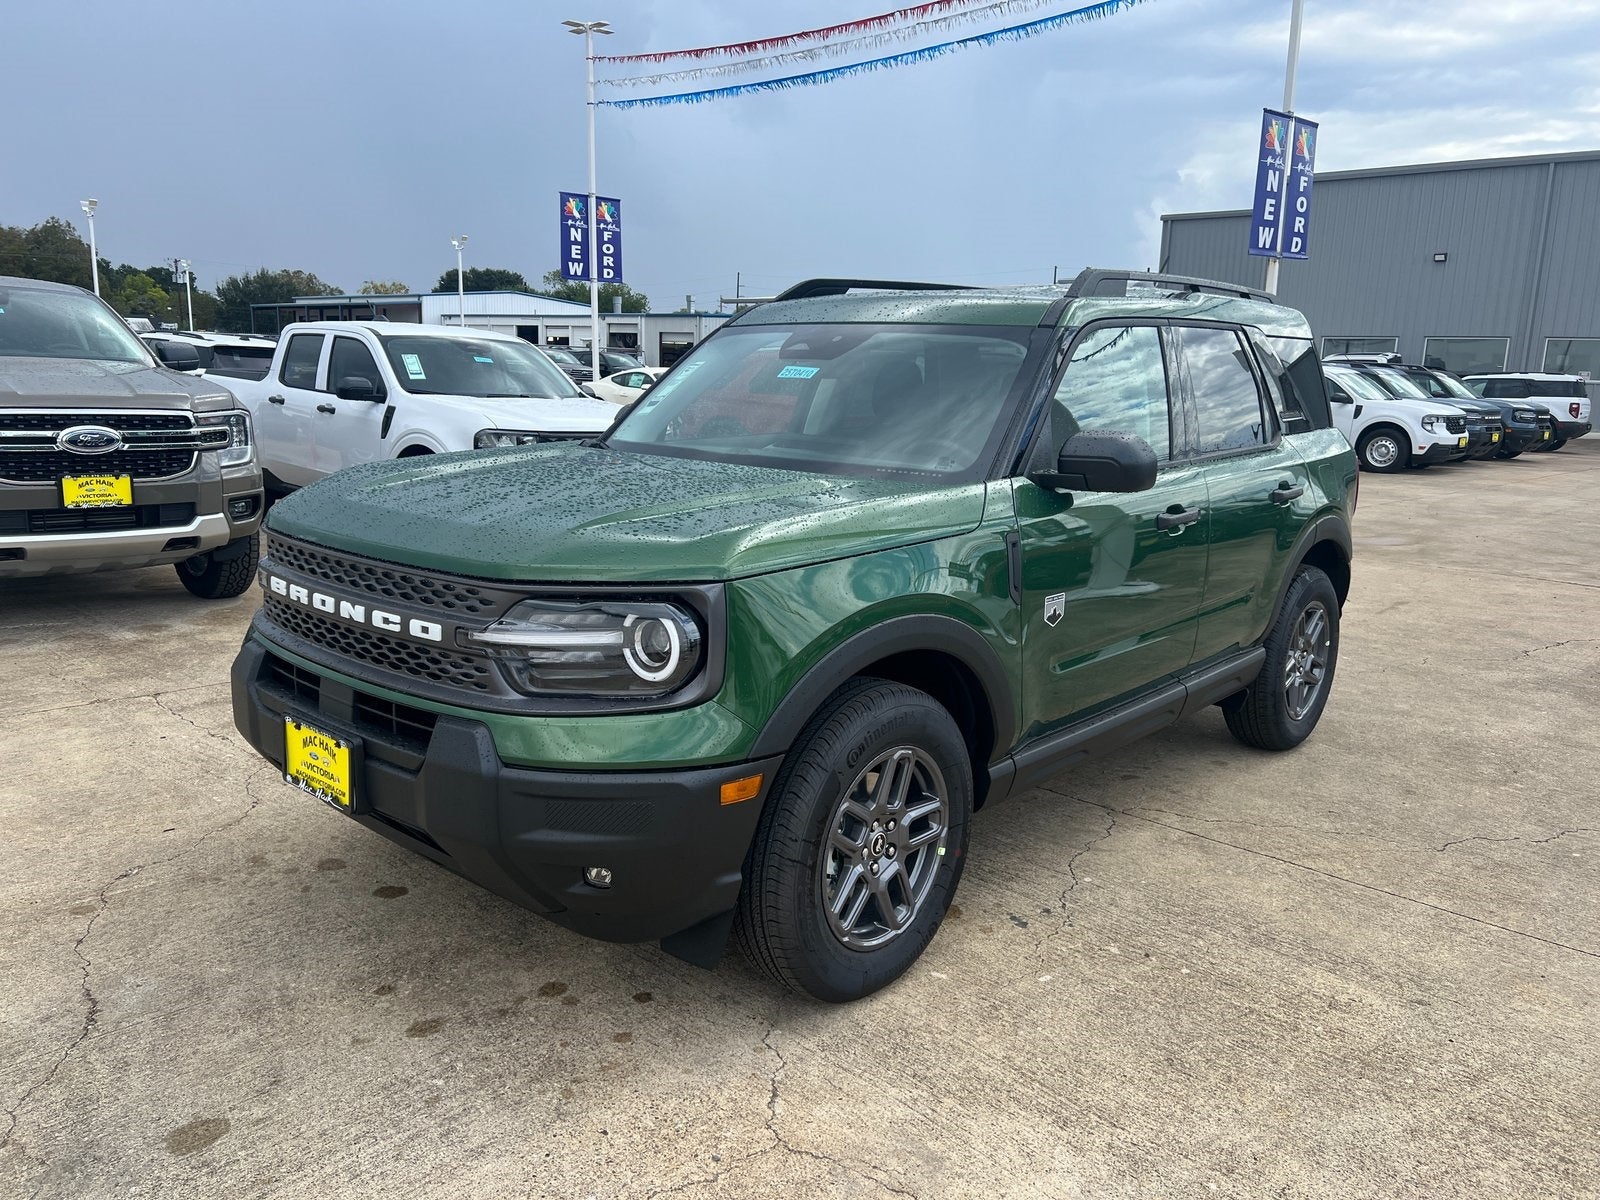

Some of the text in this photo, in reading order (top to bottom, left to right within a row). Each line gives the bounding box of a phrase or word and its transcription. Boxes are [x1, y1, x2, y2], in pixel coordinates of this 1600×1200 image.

[1258, 169, 1280, 249] NEW
[1290, 175, 1309, 254] FORD
[568, 227, 584, 276] NEW
[602, 231, 615, 279] FORD
[77, 434, 108, 446] Ford
[78, 479, 114, 489] MAC HAIK
[270, 575, 442, 642] BRONCO
[302, 735, 337, 765] MAC HAIK
[846, 711, 909, 769] Continental
[299, 778, 314, 793] Mac
[307, 761, 336, 783] VICTORIA
